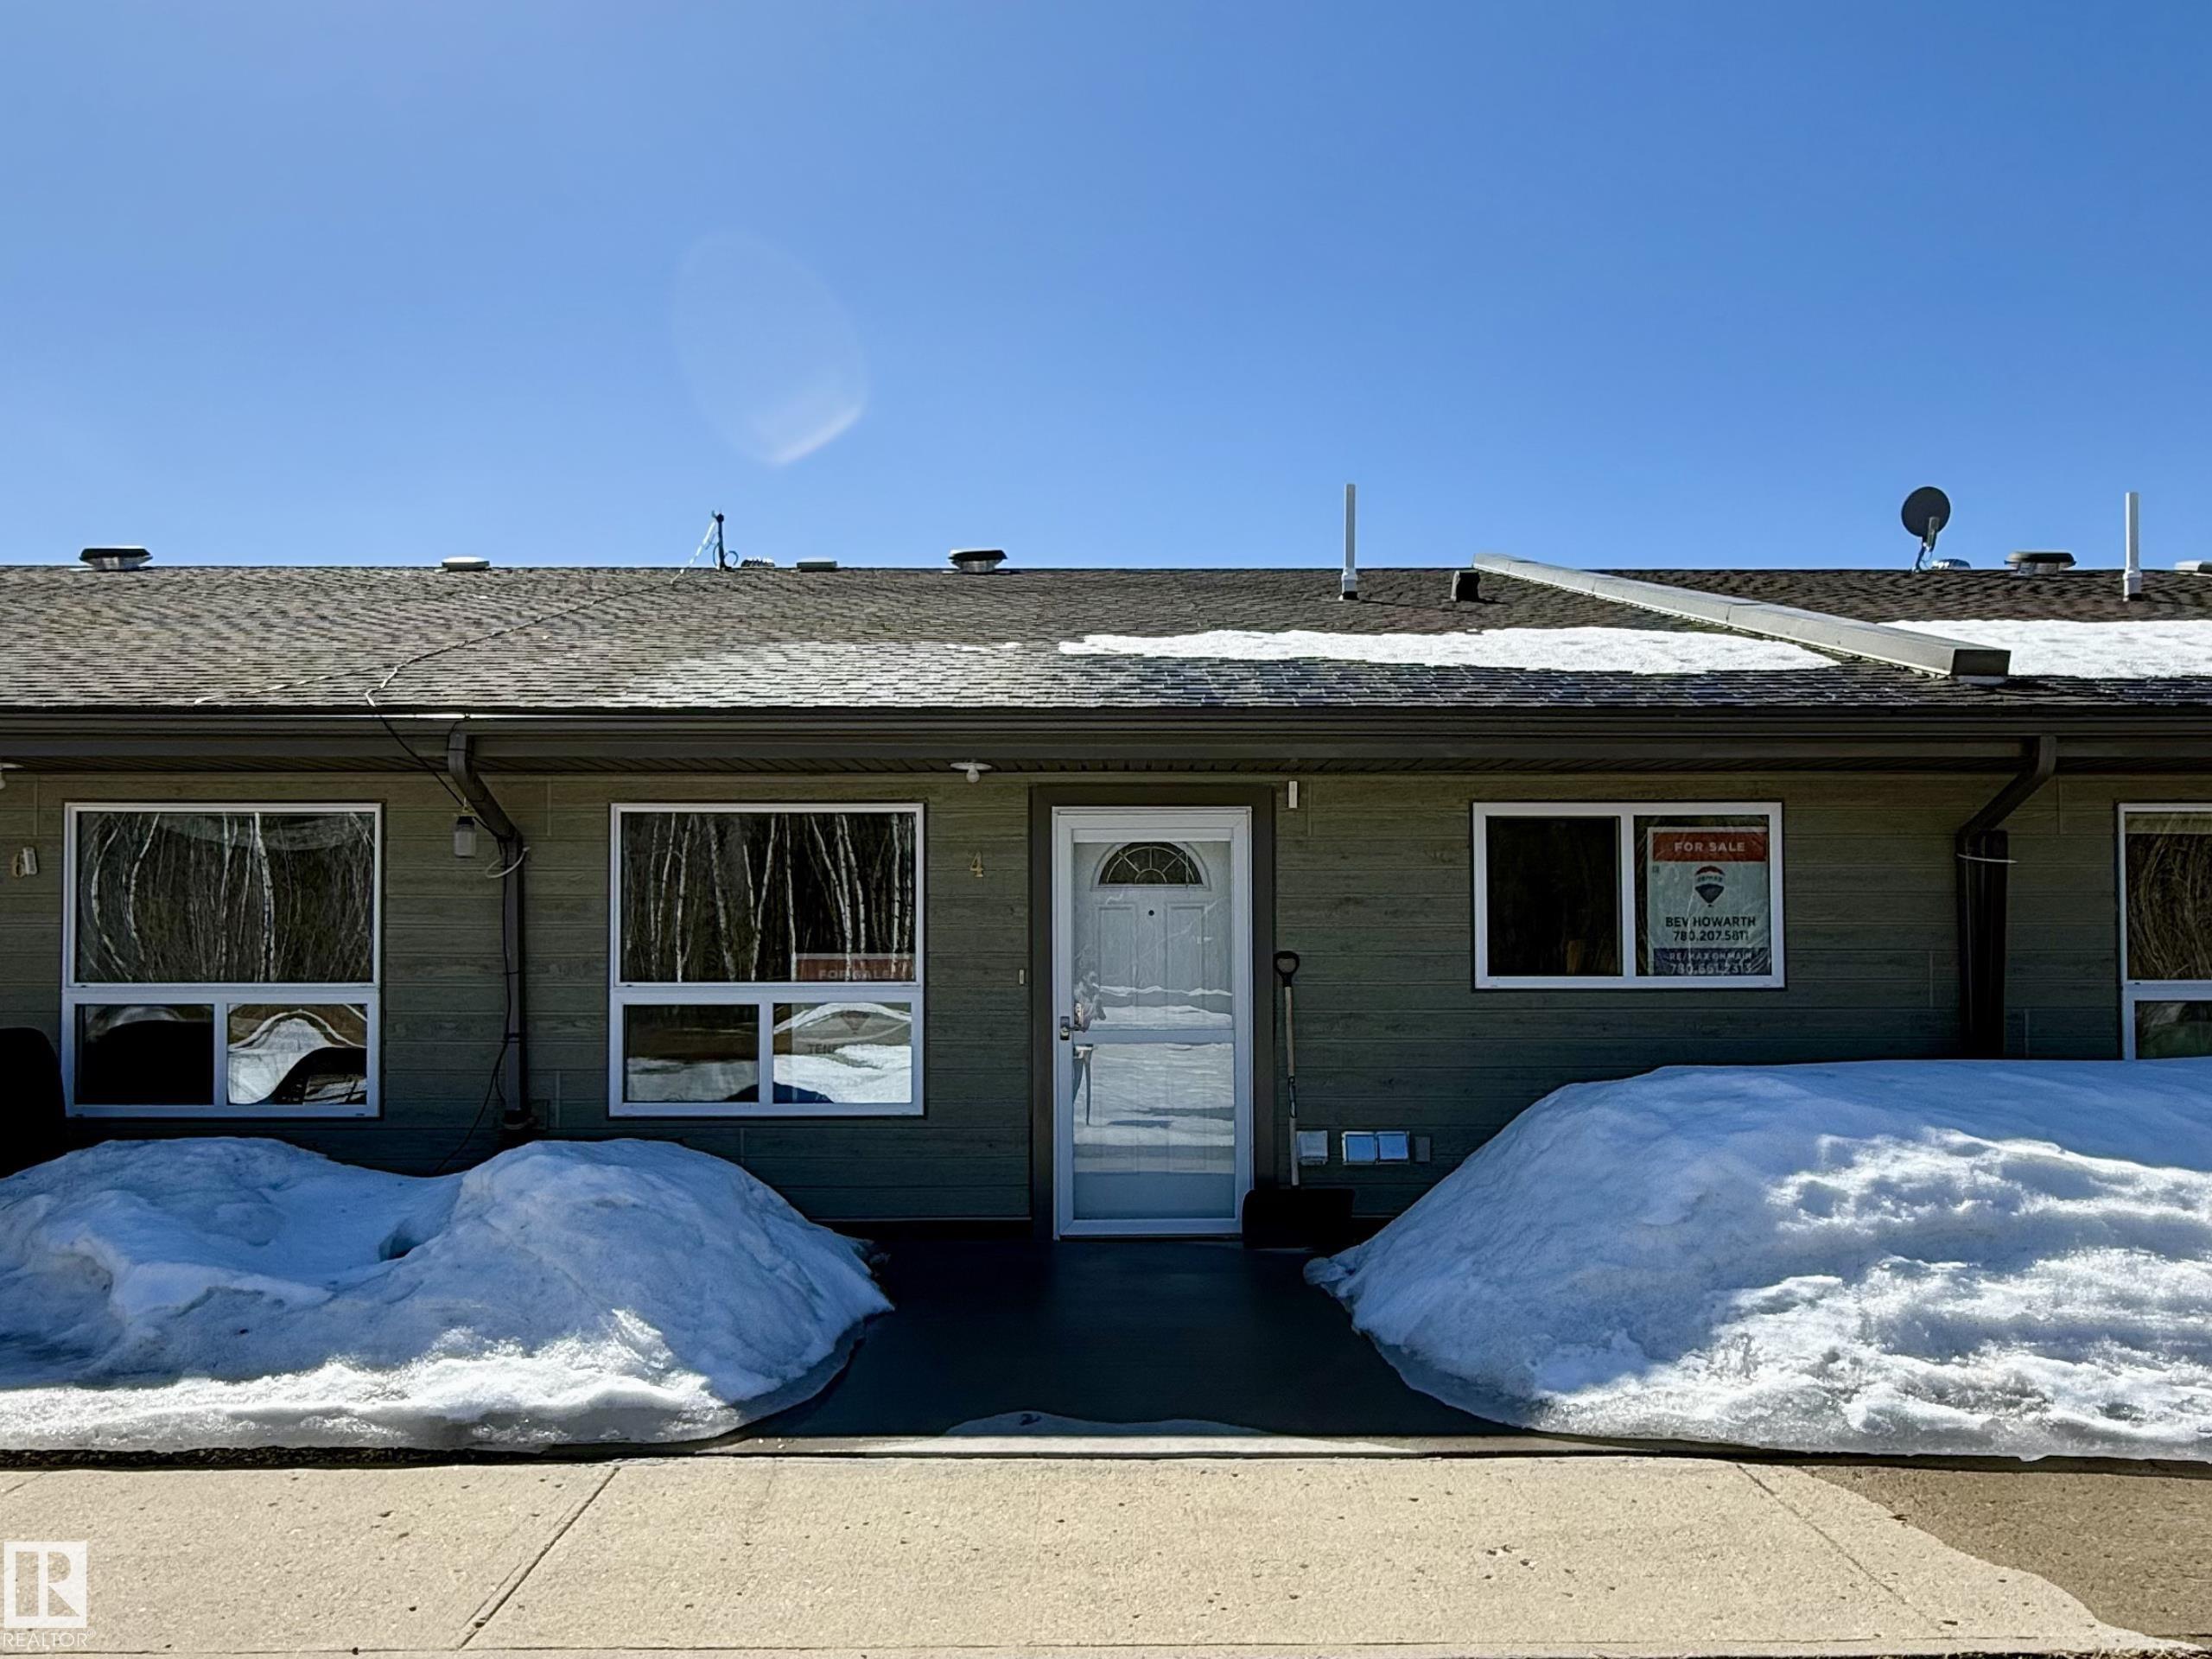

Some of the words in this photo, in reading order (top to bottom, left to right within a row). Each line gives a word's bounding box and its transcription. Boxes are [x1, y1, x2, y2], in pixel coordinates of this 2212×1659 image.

[1674, 841, 1704, 853] FOR
[1708, 841, 1745, 853] SALE
[969, 851, 984, 878] 4
[1665, 916, 1688, 927] BEV
[1693, 916, 1757, 927] HOWARTH
